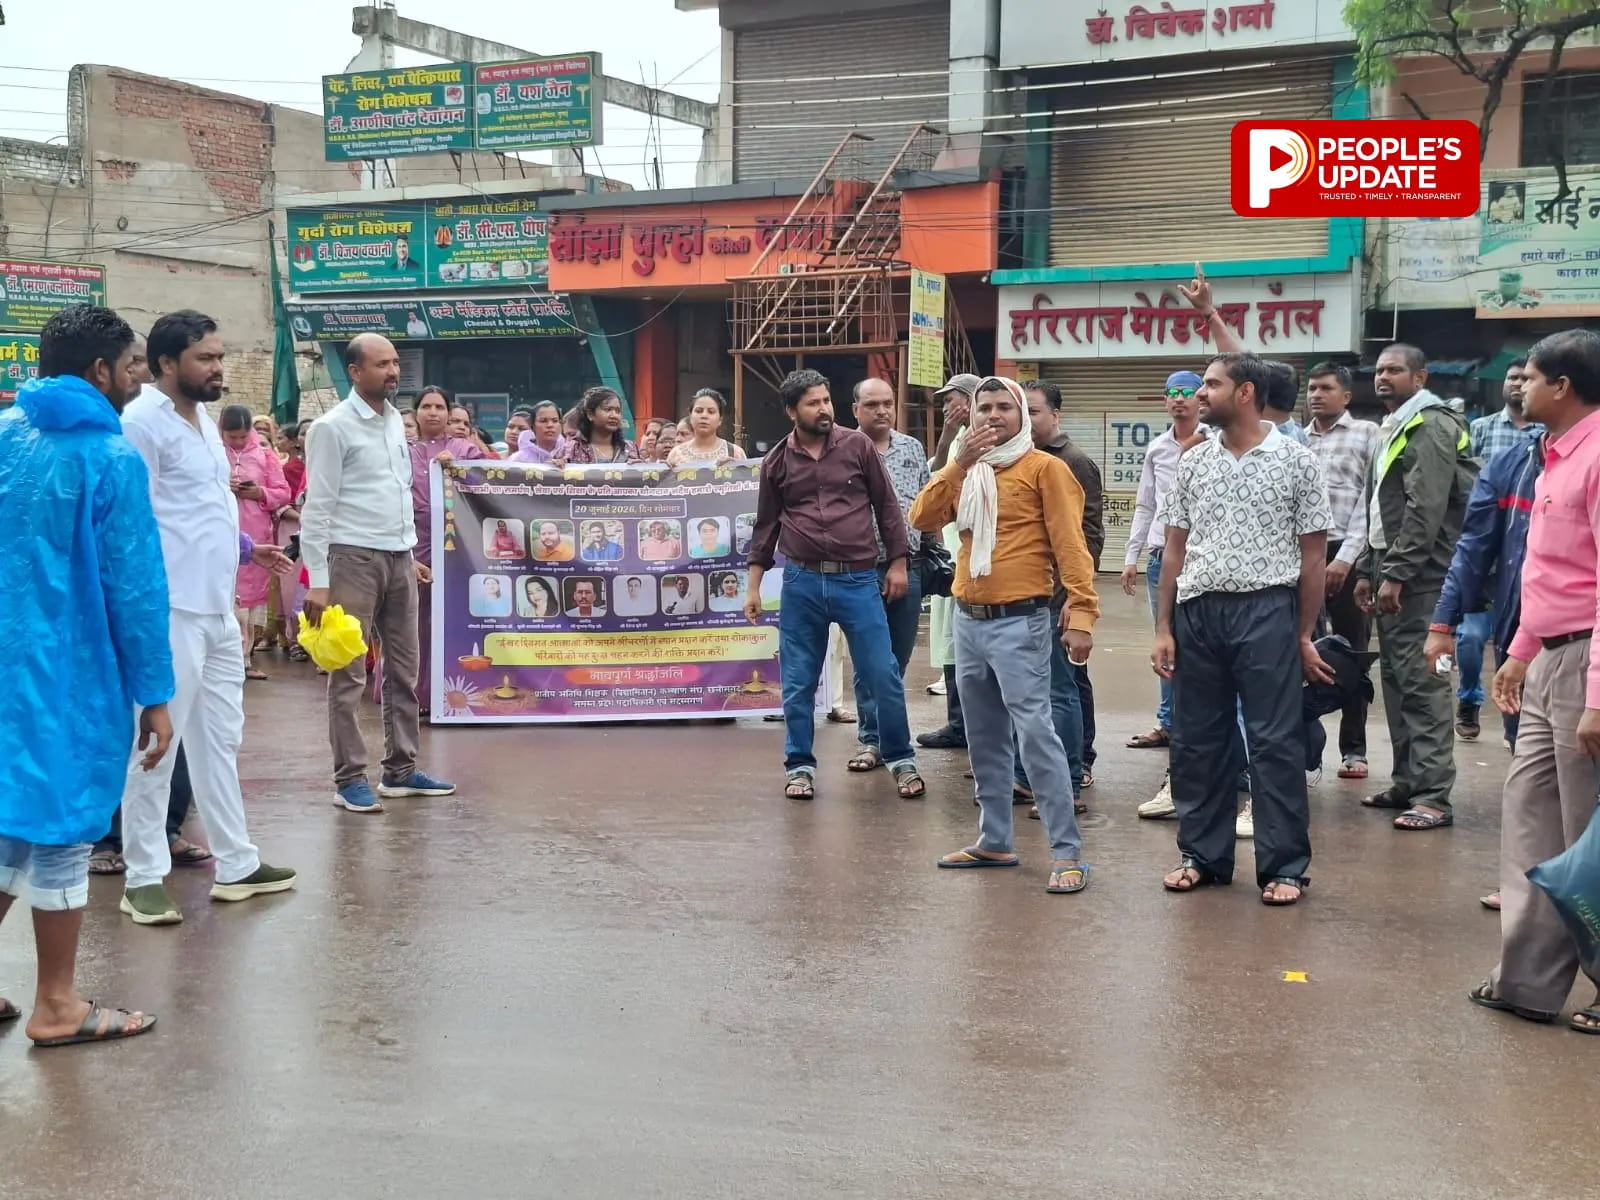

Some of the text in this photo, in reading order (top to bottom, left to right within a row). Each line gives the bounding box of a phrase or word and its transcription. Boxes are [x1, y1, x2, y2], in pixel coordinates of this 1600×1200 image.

[1086, 0, 1275, 44] डॉ. विवेक शर्मा
[495, 78, 572, 104] डॉ. यश जैन
[357, 92, 432, 110] रोग विशेषज्ञ
[328, 116, 348, 133] डॉ.
[1535, 186, 1585, 230] साई
[298, 220, 413, 242] गुर्दा रोग विशेषज्ञ
[456, 220, 473, 240] डॉ.
[318, 242, 332, 260] डॉ.
[1521, 248, 1543, 262] हमारे
[1585, 268, 1598, 278] रस
[6, 275, 20, 292] डॉ.
[464, 320, 496, 328] (Chemist
[506, 318, 540, 327] Druggist)
[1009, 282, 1325, 352] हरिराज मेडिकल हॉल
[23, 344, 40, 362] रो
[8, 364, 25, 379] डॉ.
[1111, 422, 1174, 448] TO-
[587, 484, 596, 496] के
[596, 484, 612, 496] प्रति
[613, 486, 638, 496] आपका
[638, 484, 671, 496] योगदान
[691, 483, 712, 496] हमारी
[574, 505, 587, 513] 20
[588, 504, 610, 516] जुलाई
[639, 504, 652, 513] दिन
[654, 504, 680, 513] सोमवार
[678, 635, 698, 644] प्रदान
[730, 632, 768, 644] शोकाकुल
[686, 648, 706, 657] प्रदान
[590, 666, 684, 684] भावपूर्ण श्रद्धांजलि
[558, 688, 582, 698] अतिथि
[584, 688, 608, 698] शिक्षक
